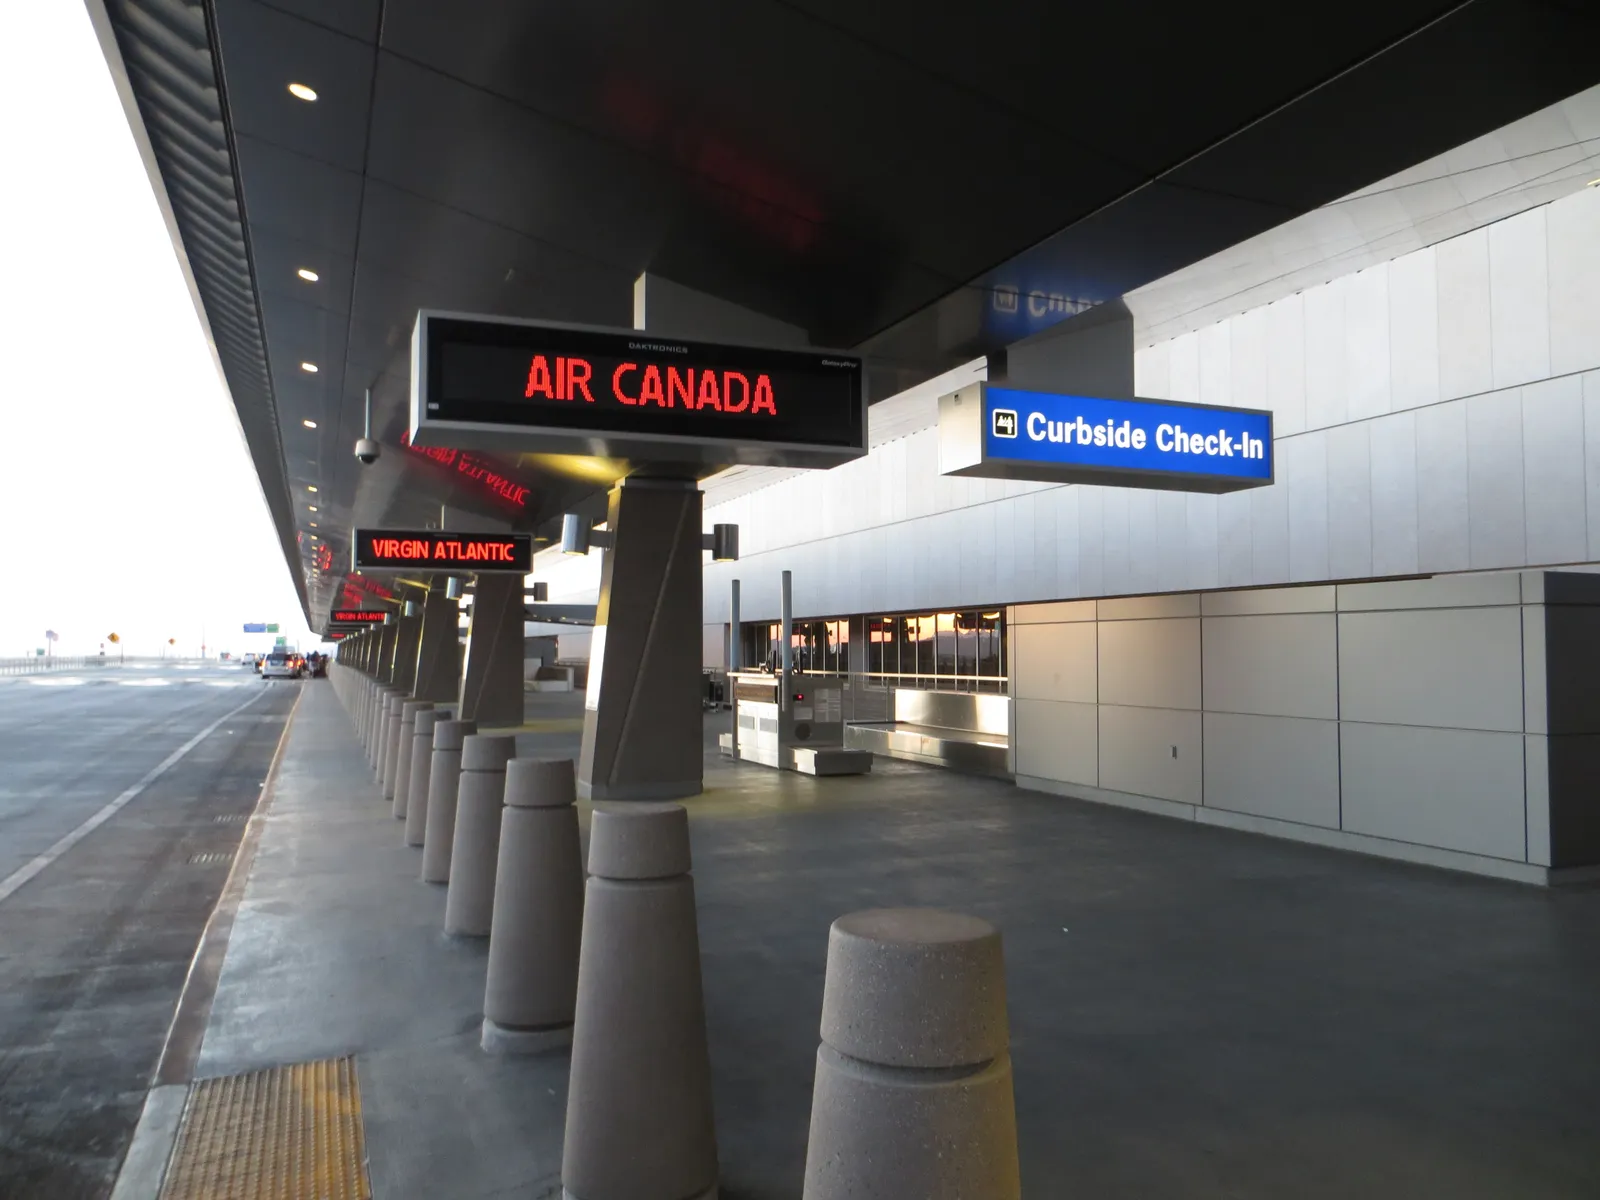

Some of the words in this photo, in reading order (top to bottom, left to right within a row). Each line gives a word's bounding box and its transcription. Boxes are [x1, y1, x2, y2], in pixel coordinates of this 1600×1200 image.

[628, 342, 688, 354] DAKTRONICS
[524, 354, 595, 403] AIR
[612, 362, 777, 416] CANADA
[1026, 411, 1147, 450] Curbside
[1156, 423, 1264, 460] Check-In
[372, 539, 429, 559] VIRGIN
[434, 541, 515, 562] ATLANTIC
